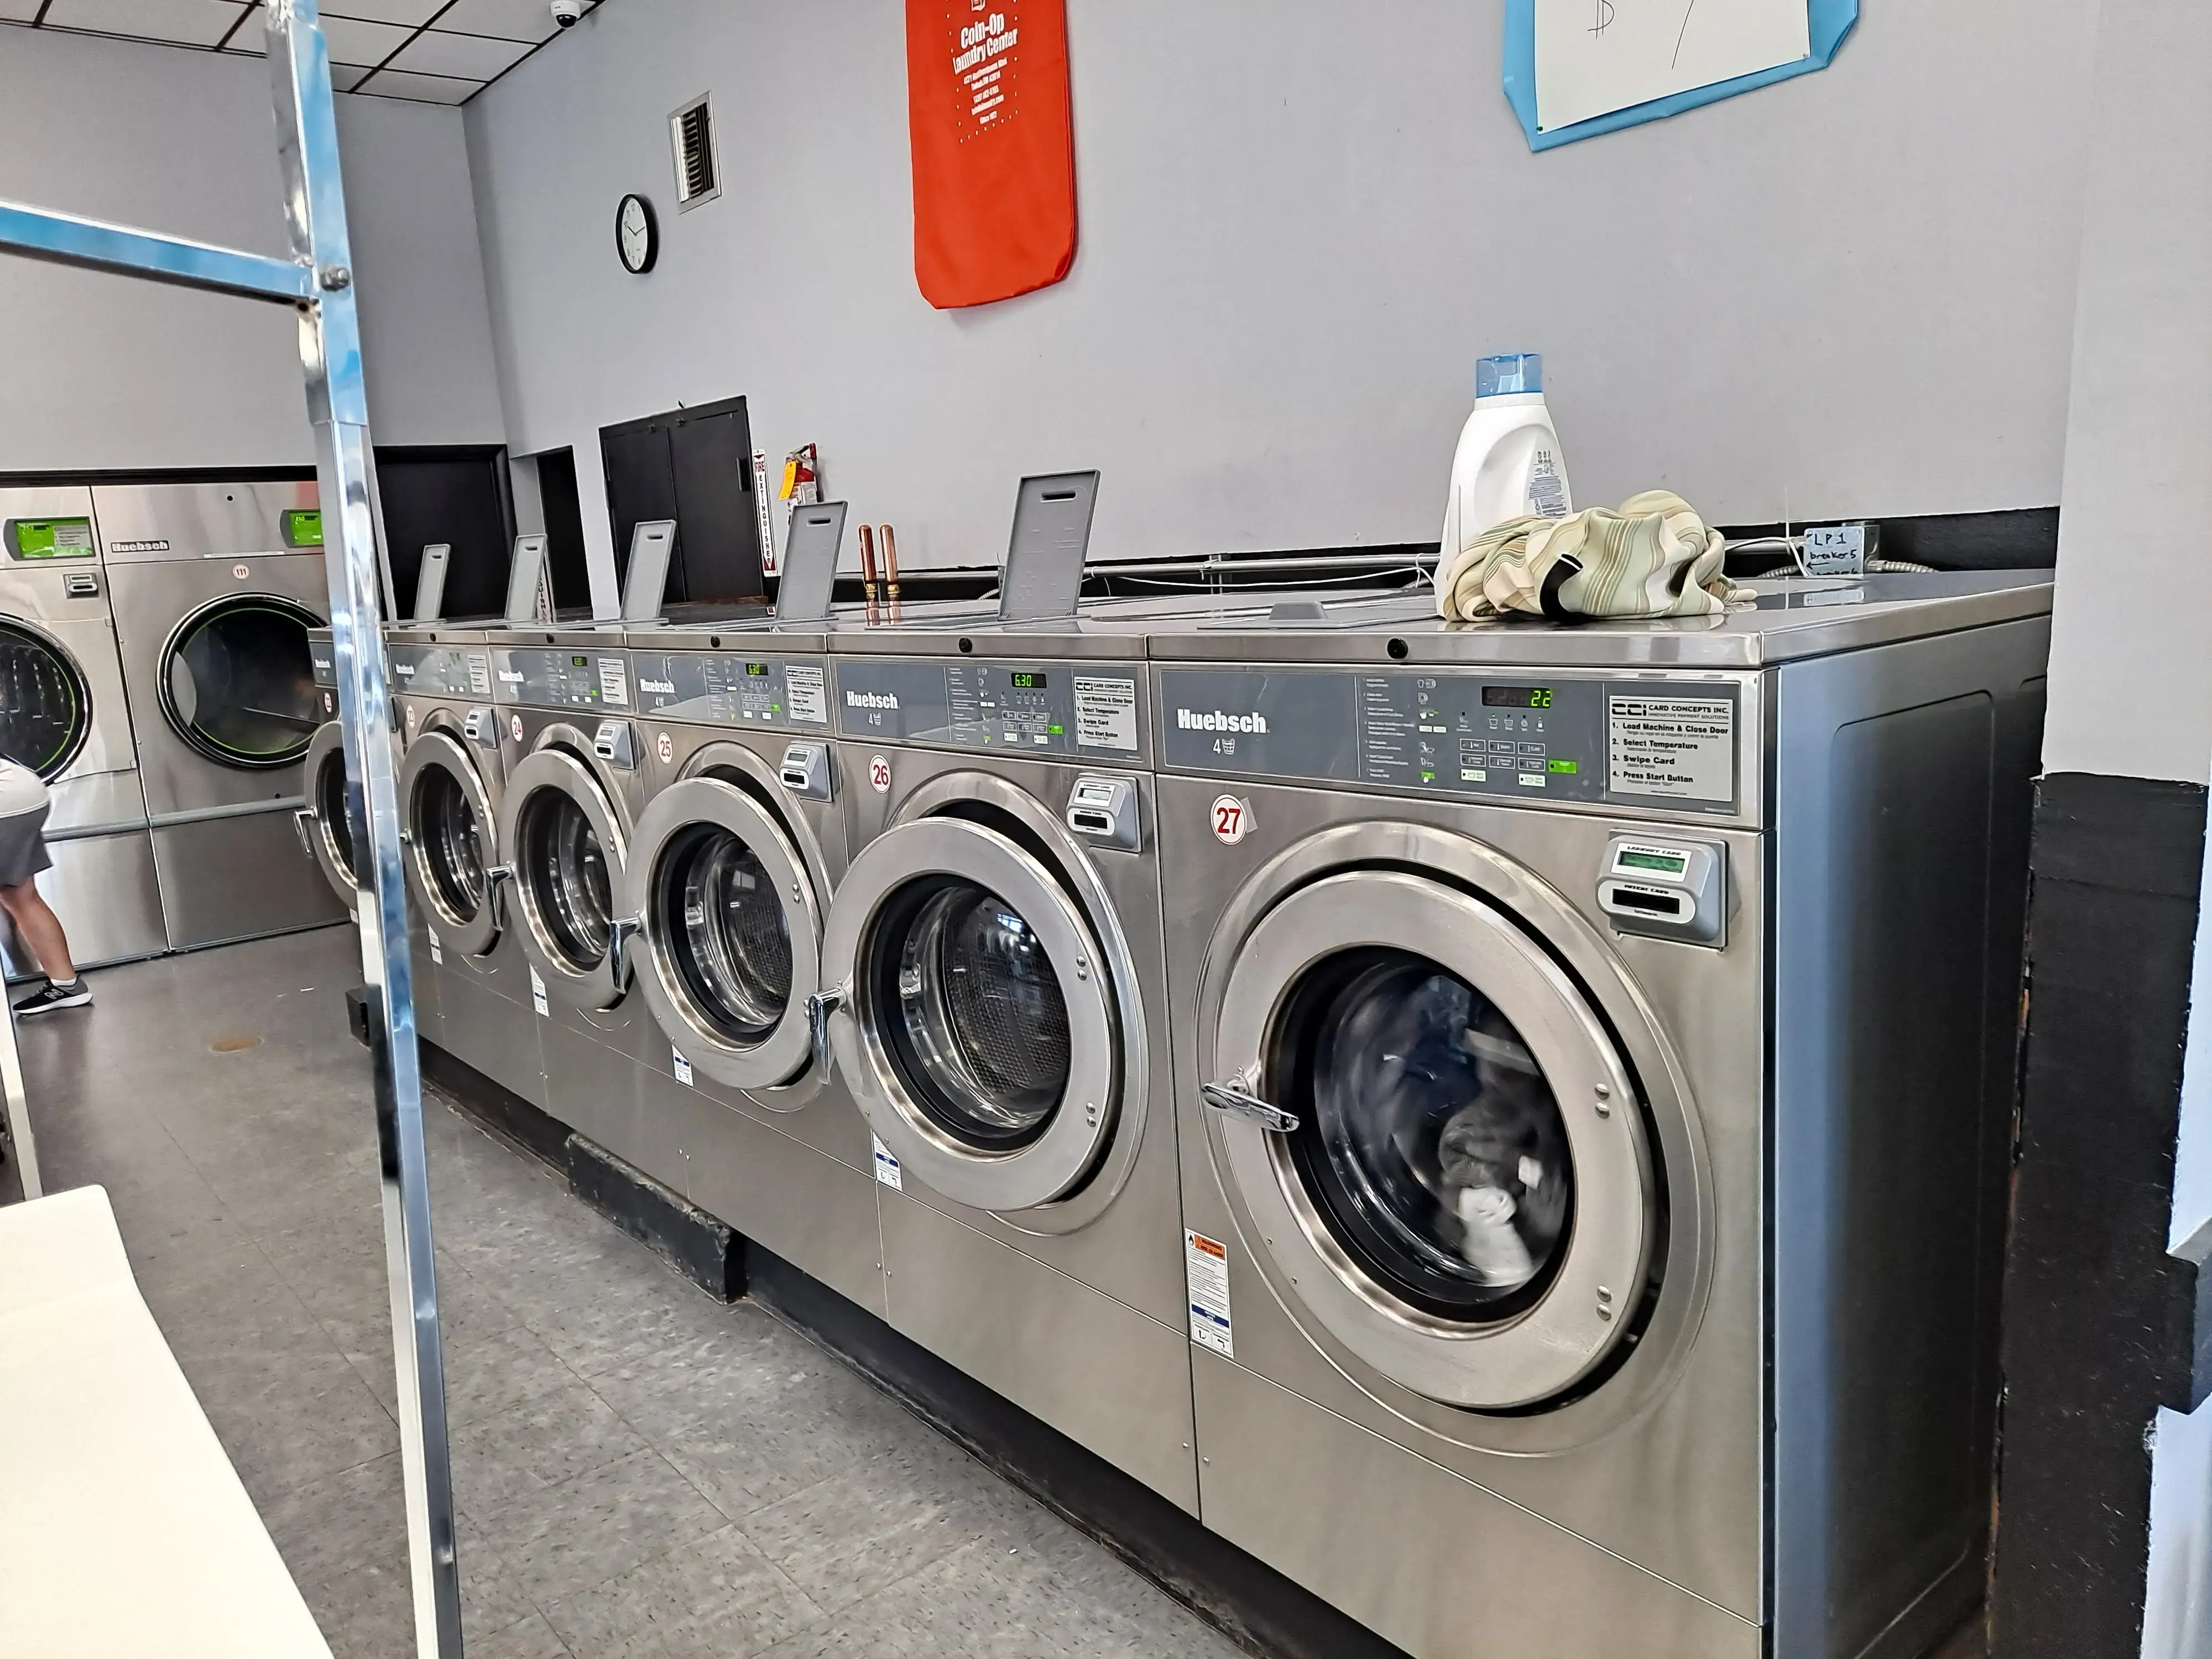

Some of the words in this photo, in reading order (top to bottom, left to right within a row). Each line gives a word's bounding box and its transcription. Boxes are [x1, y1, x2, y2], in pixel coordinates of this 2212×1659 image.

[961, 13, 1004, 49] Coin-Op
[952, 44, 986, 75] Laundry
[987, 28, 1018, 56] Center
[759, 474, 771, 564] EXTINGUISHER
[112, 541, 168, 552] Huebsch
[1850, 549, 1857, 559] 5
[236, 568, 247, 576] 111
[640, 678, 675, 693] Huebsch
[846, 691, 899, 709] Huebsch
[868, 713, 874, 725] 4
[1177, 708, 1267, 734] Huebsch
[513, 721, 521, 735] 24
[1642, 723, 1674, 732] Machine
[1685, 725, 1708, 733] Close
[1709, 726, 1729, 734] Door
[660, 740, 671, 757] 25
[1213, 739, 1221, 754] 4
[1623, 738, 1647, 747] Select
[1649, 740, 1698, 750] Temperature
[1623, 755, 1651, 764] Swipe
[1653, 757, 1675, 765] Card
[873, 764, 889, 786] 26
[1623, 771, 1644, 779] Press
[1646, 773, 1665, 781] Start
[1667, 774, 1693, 783] Button
[1216, 807, 1241, 834] 27
